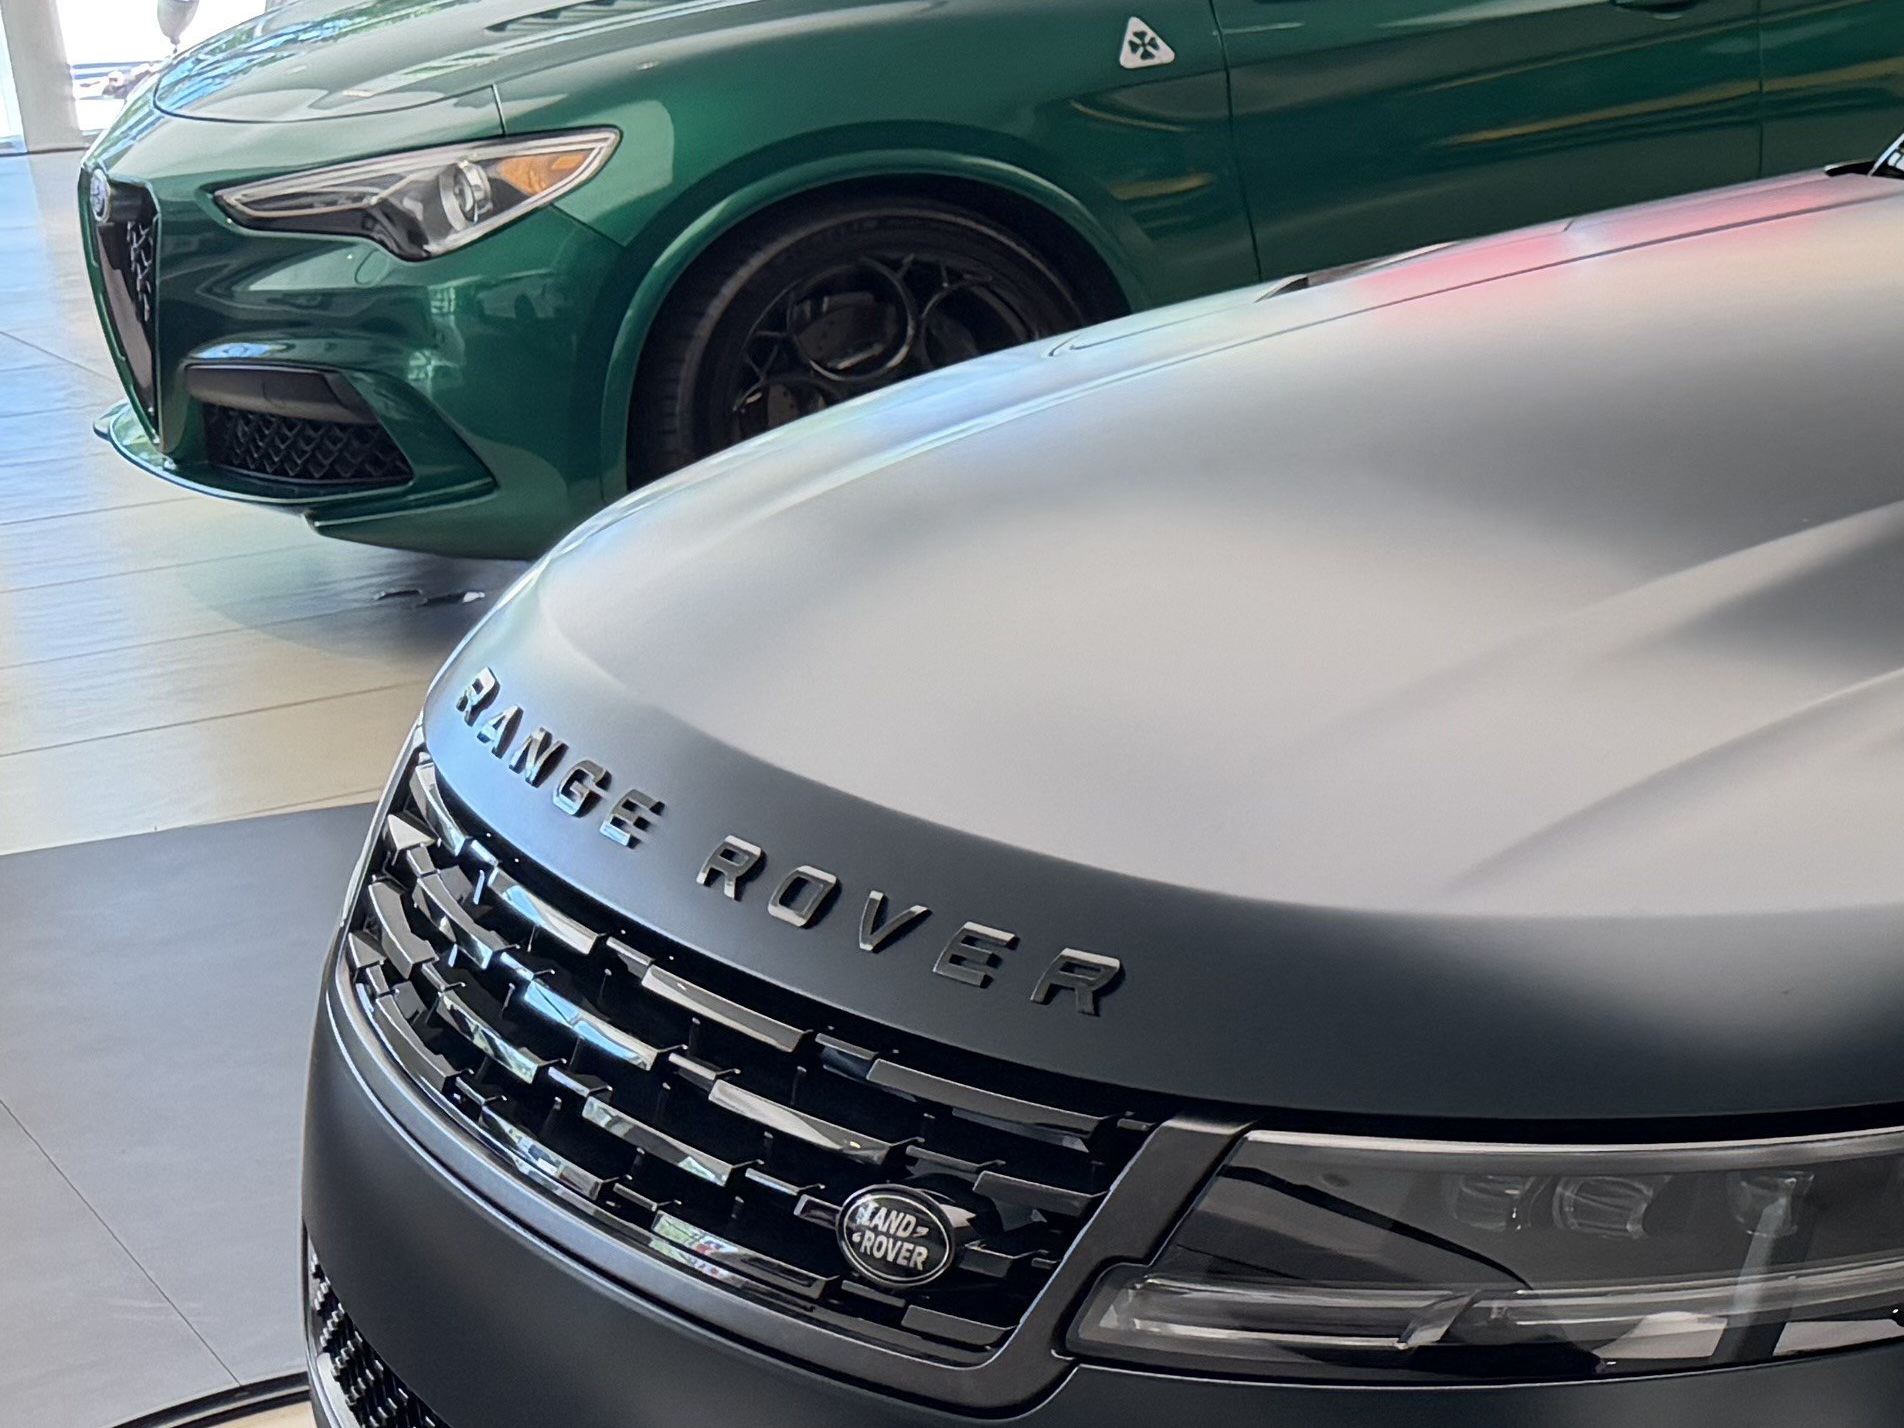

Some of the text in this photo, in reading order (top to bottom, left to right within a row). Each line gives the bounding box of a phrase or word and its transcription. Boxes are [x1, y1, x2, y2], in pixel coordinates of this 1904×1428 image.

[456, 667, 1124, 1016] RANGE ROVER
[854, 1202, 918, 1238] LAND
[859, 1229, 929, 1271] ROVER
